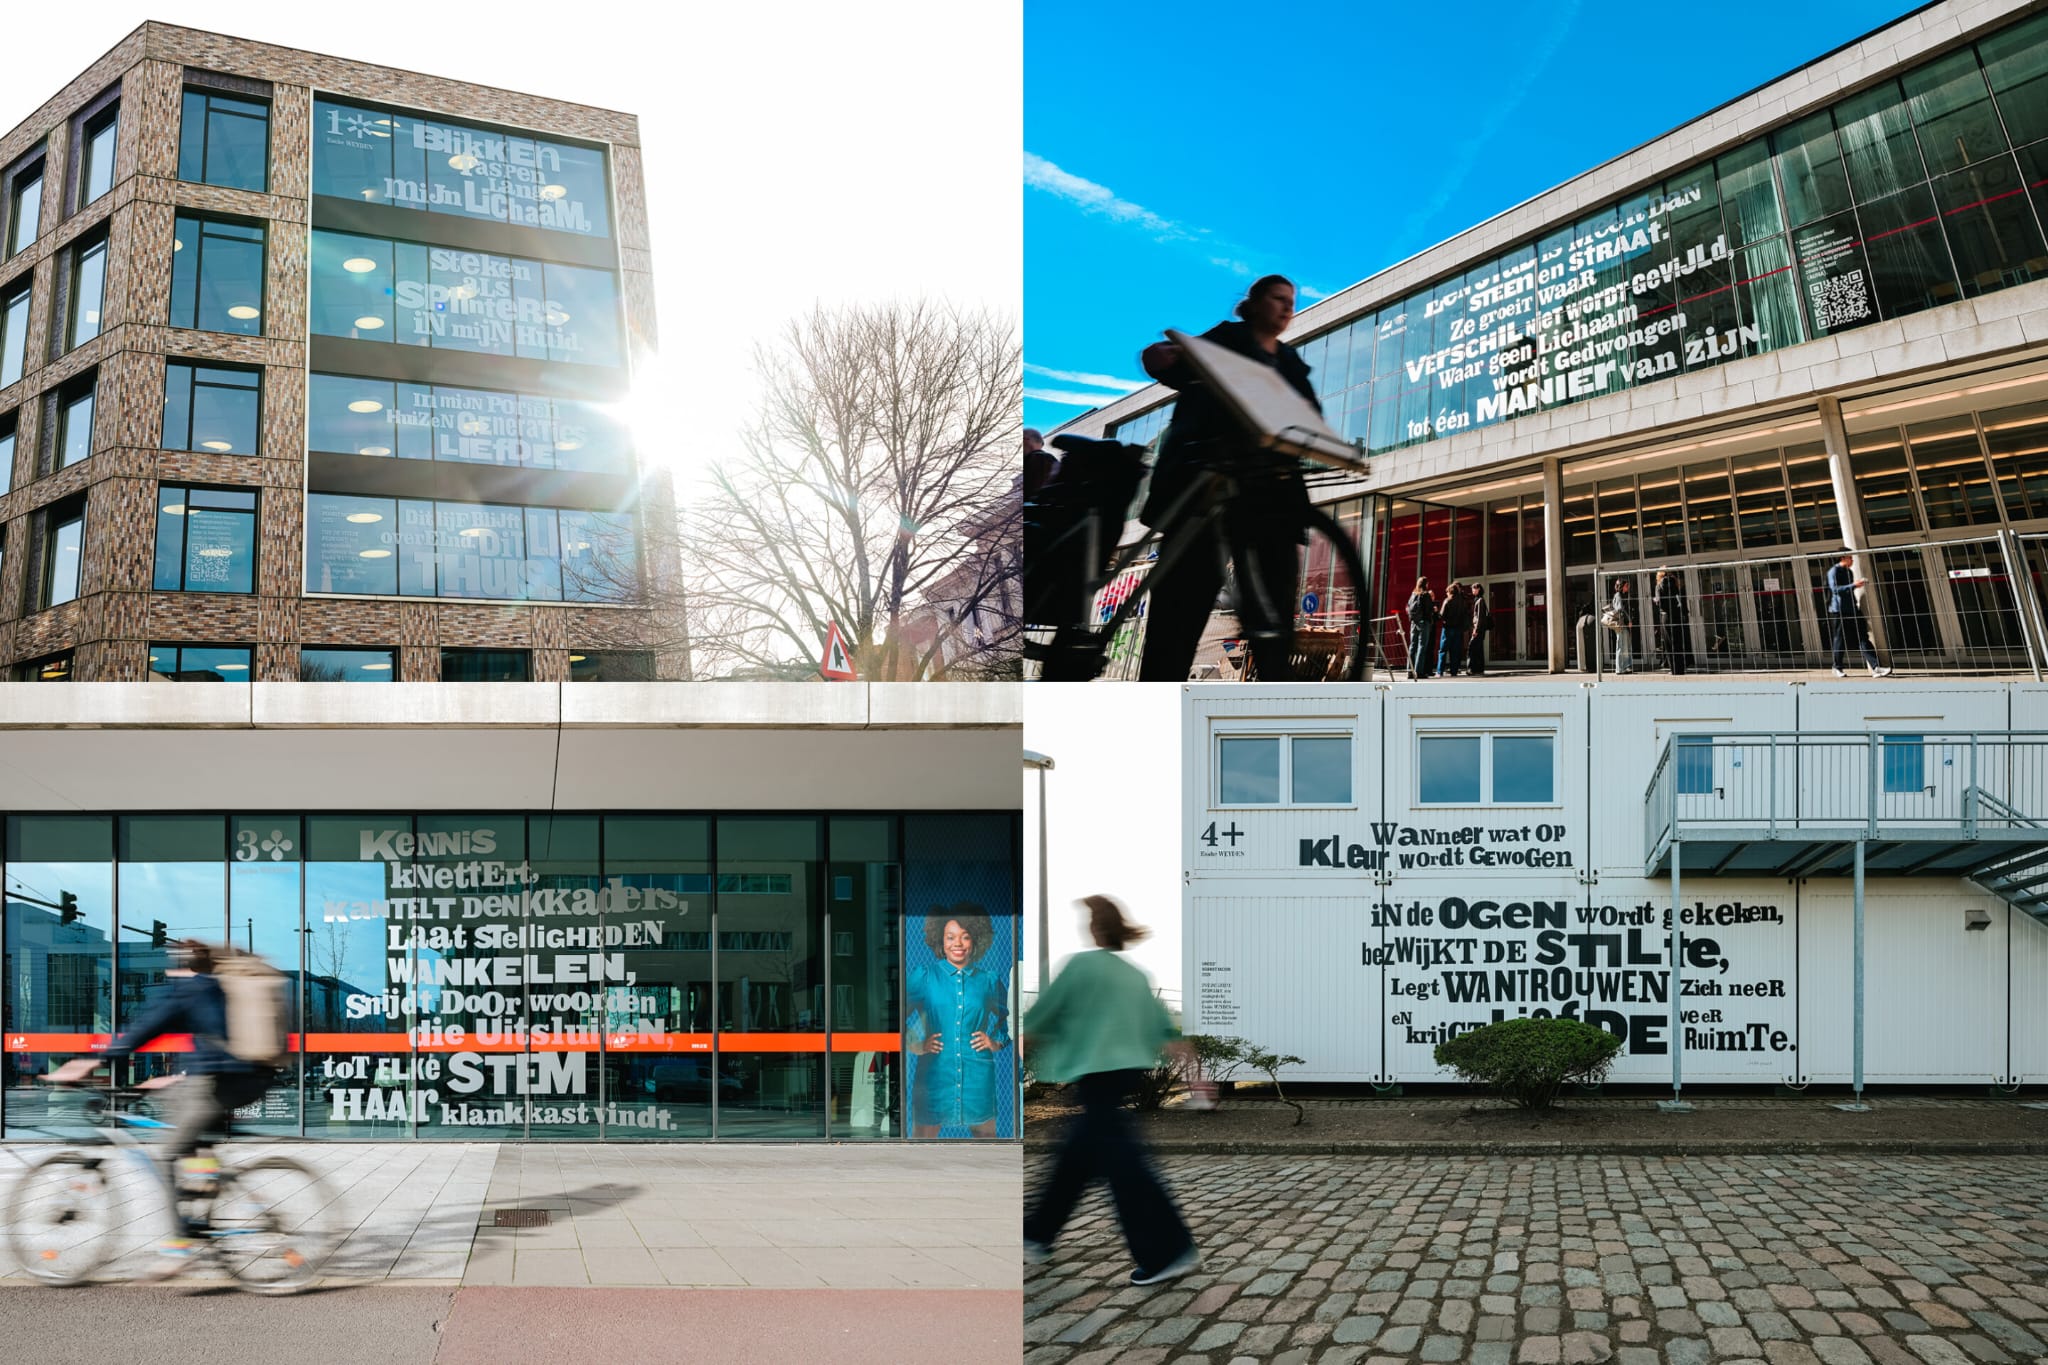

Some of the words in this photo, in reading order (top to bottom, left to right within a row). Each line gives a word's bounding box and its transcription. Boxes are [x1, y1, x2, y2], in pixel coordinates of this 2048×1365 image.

[1538, 262, 1564, 285] en
[1450, 317, 1475, 342] Ze
[1439, 359, 1484, 390] Waar
[1489, 344, 1532, 375] geen
[1539, 303, 1638, 355] Lichaam
[1493, 357, 1550, 391] wordt
[1555, 312, 1688, 370] Gedwongen
[1408, 416, 1431, 438] tot
[1435, 408, 1470, 433] één
[1619, 351, 1678, 383] van
[236, 830, 259, 862] 3
[1489, 825, 1531, 843] wat
[1406, 901, 1434, 927] de
[387, 923, 467, 951] Laat
[1483, 940, 1527, 963] DE
[387, 952, 637, 987] WANKELEN,
[1390, 978, 1440, 1000] Legt
[1441, 966, 1671, 1003] WANTROUWEN
[346, 988, 433, 1019] Snijdt
[409, 1016, 465, 1047] die
[446, 1051, 586, 1095] STEM
[593, 1101, 678, 1131] vindt.
